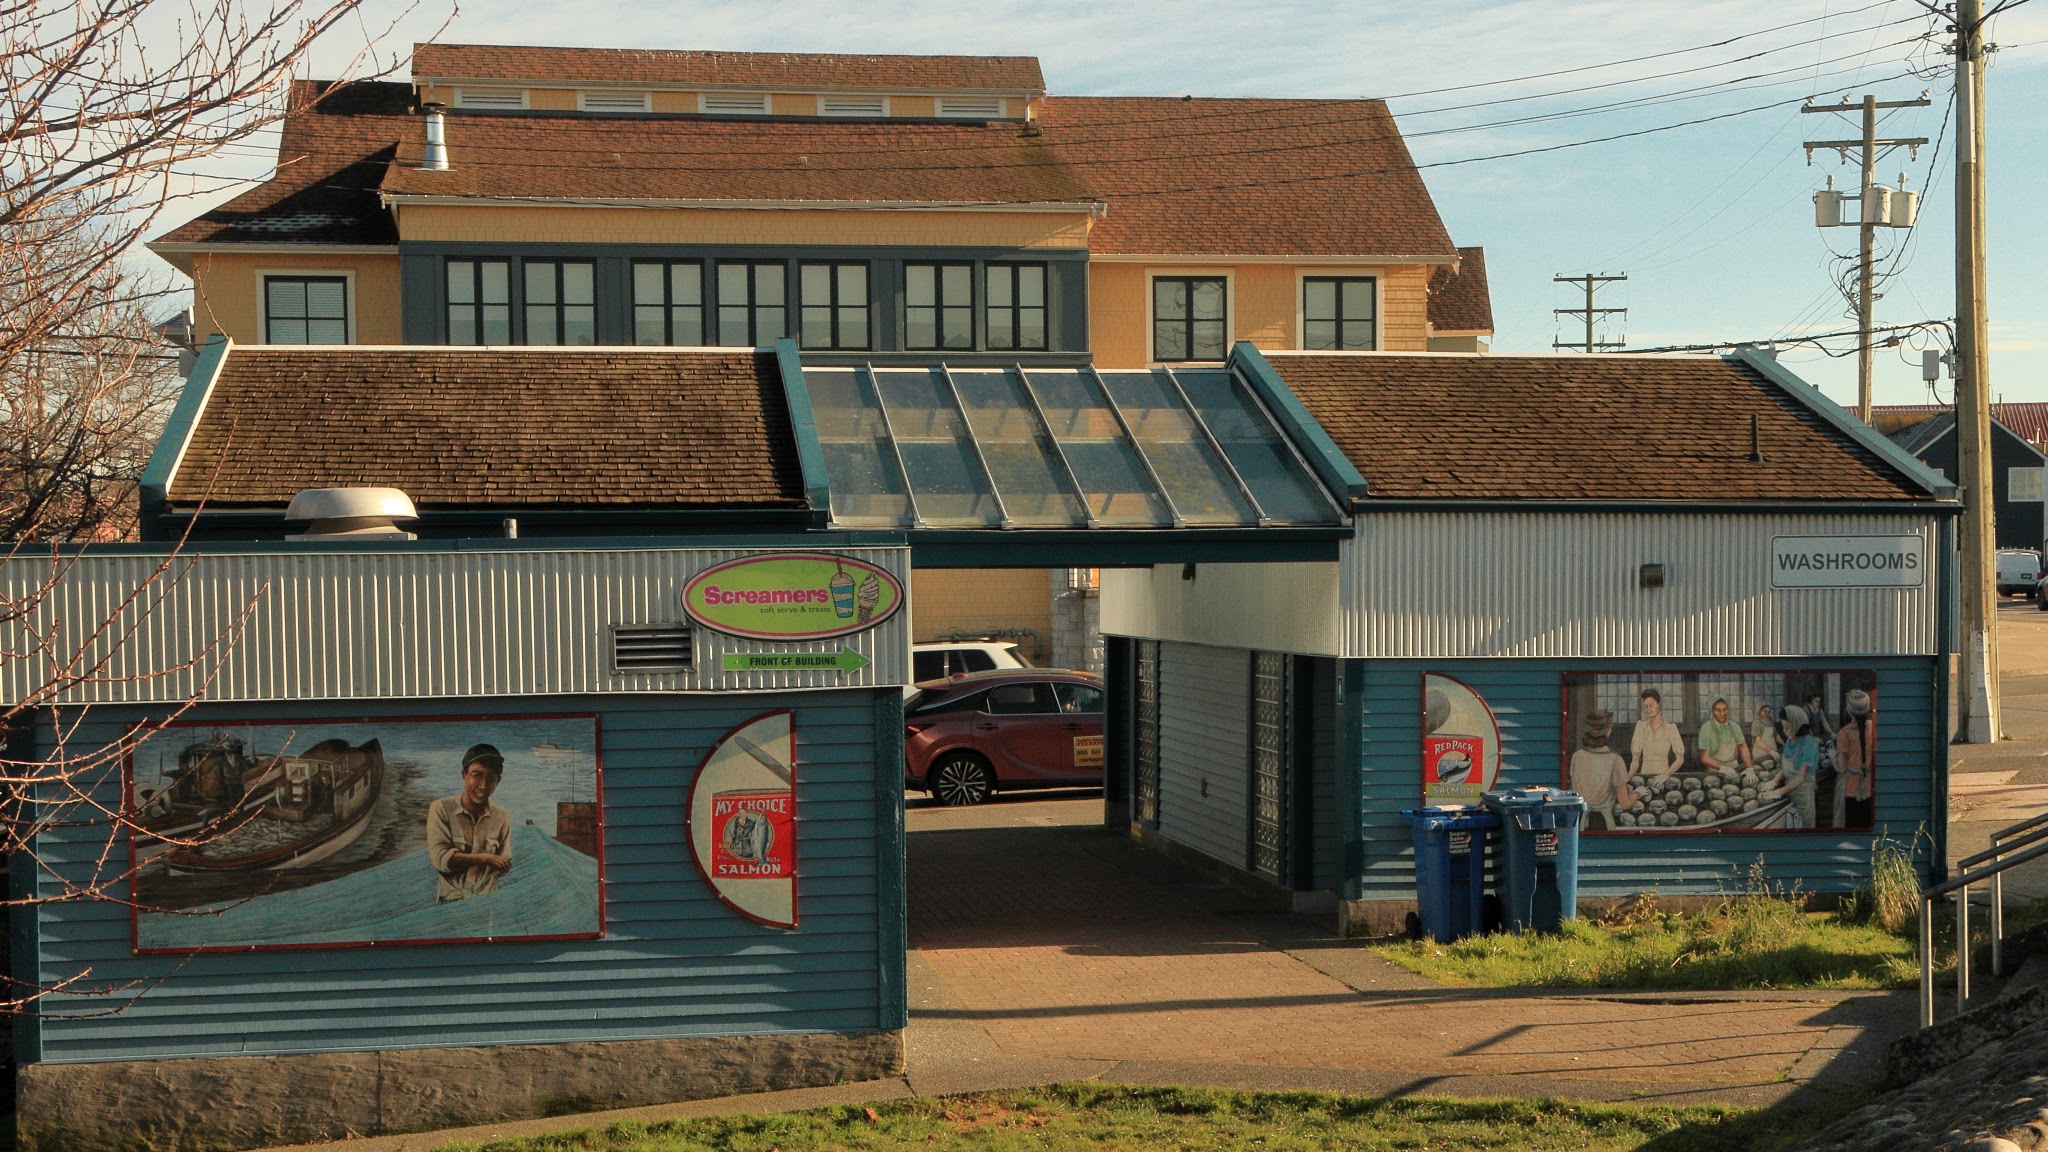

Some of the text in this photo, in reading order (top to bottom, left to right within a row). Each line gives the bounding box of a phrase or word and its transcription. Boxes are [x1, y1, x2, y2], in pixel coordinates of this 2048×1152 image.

[1778, 552, 1917, 570] WASHROOMS
[703, 585, 829, 605] Screamers
[760, 606, 774, 614] soft
[750, 656, 837, 666] FRONT OF BUILDING
[1433, 786, 1474, 794] SALMON
[715, 798, 787, 817] MY CHOICE
[718, 863, 781, 875] SALMON
